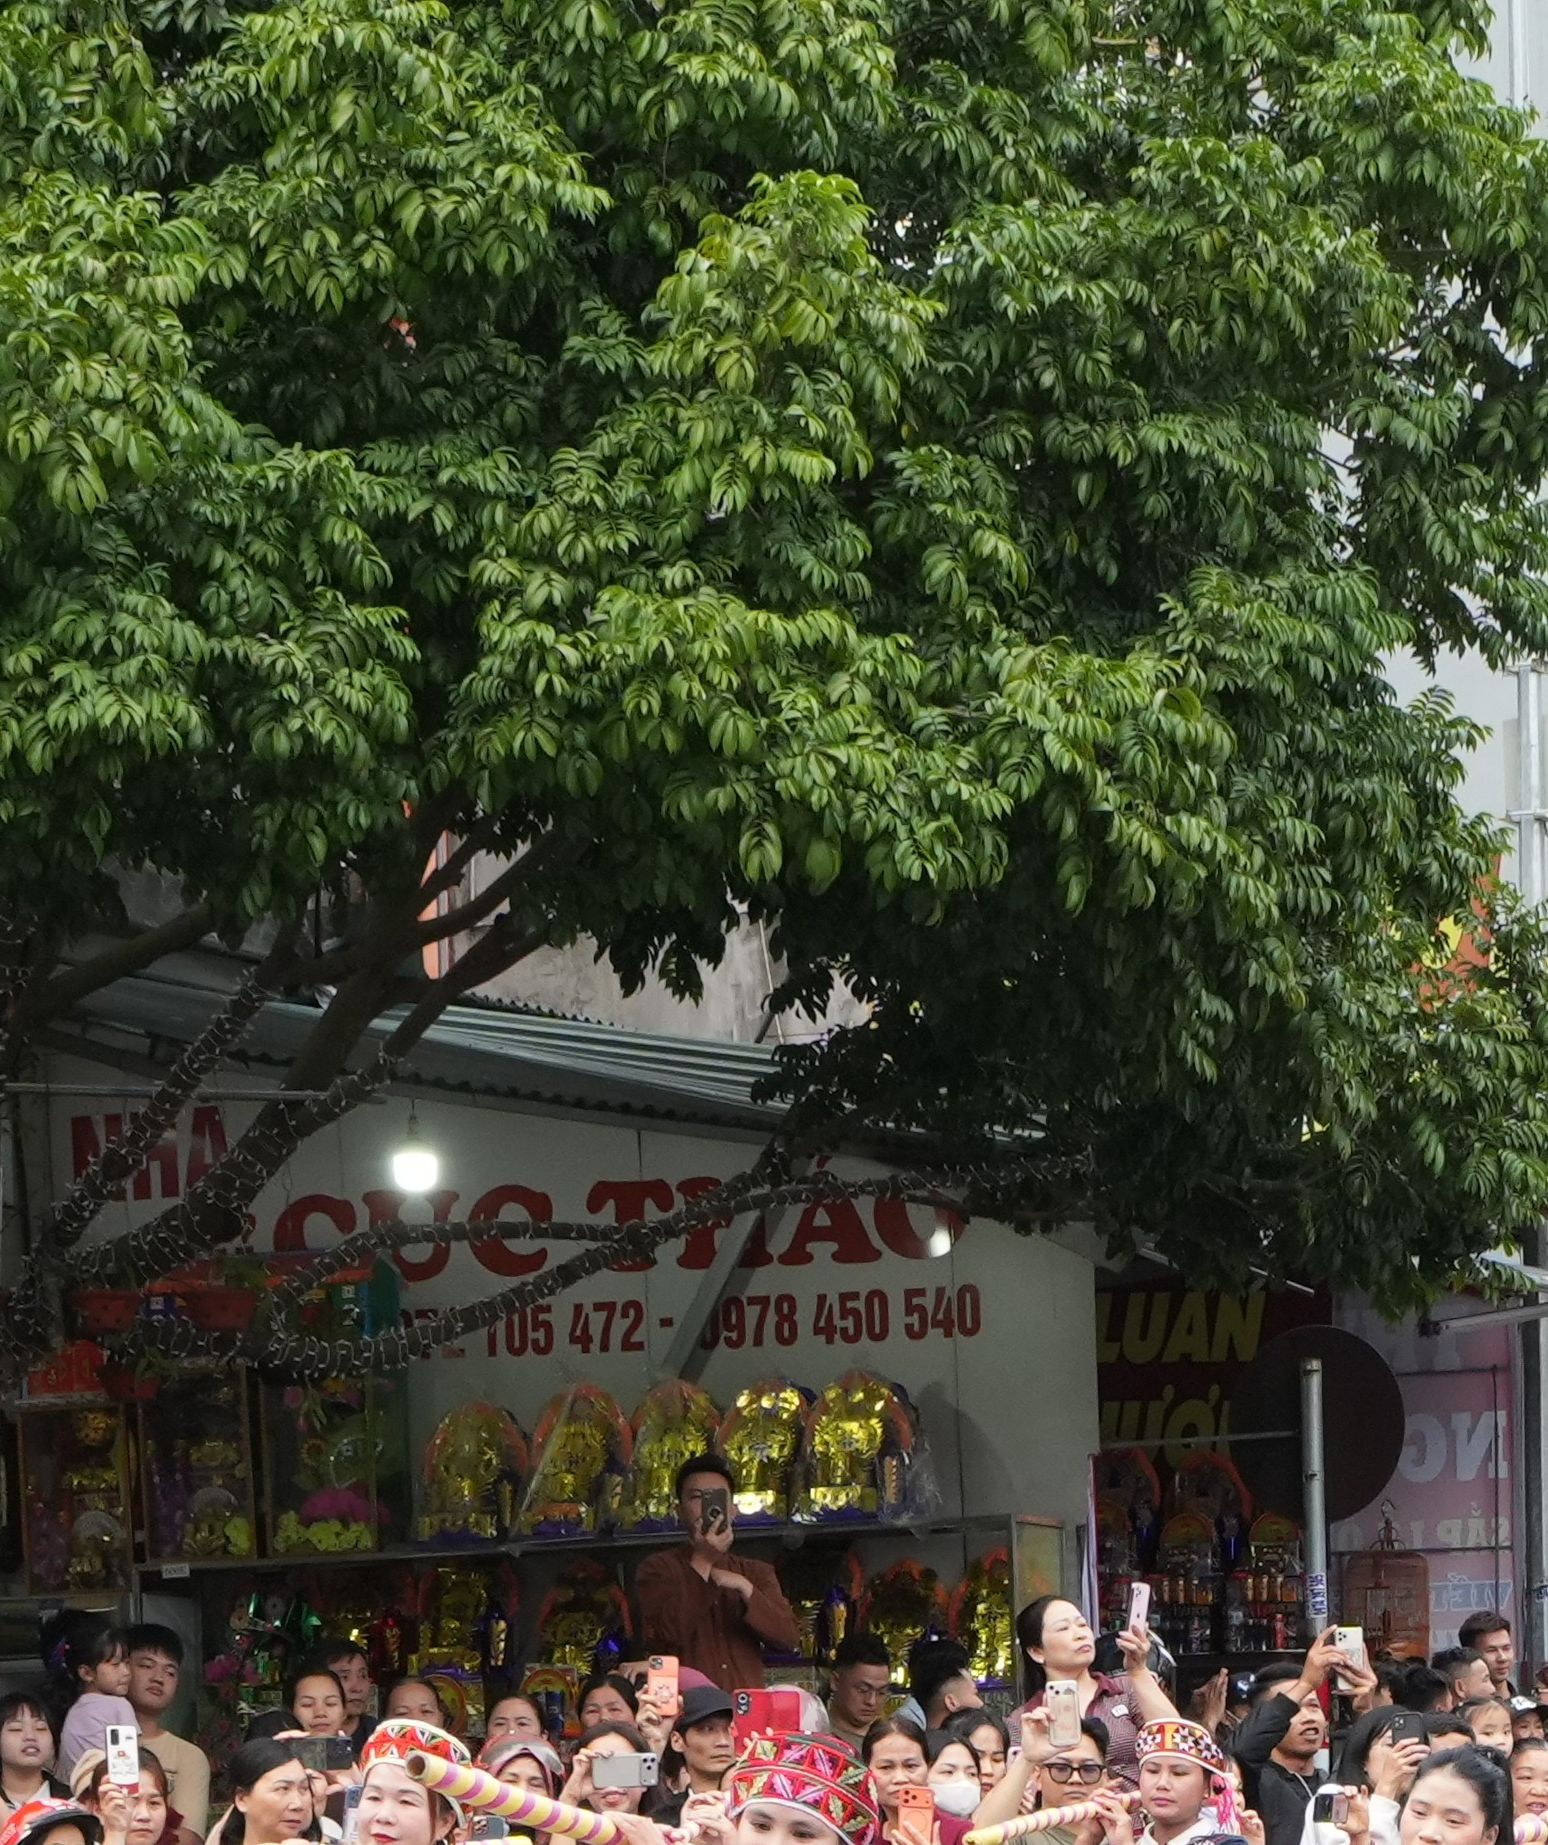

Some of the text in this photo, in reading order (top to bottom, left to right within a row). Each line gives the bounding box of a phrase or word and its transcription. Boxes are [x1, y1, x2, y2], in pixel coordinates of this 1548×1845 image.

[569, 1300, 645, 1353] 472
[813, 1290, 889, 1344] 450
[903, 1283, 981, 1341] 540
